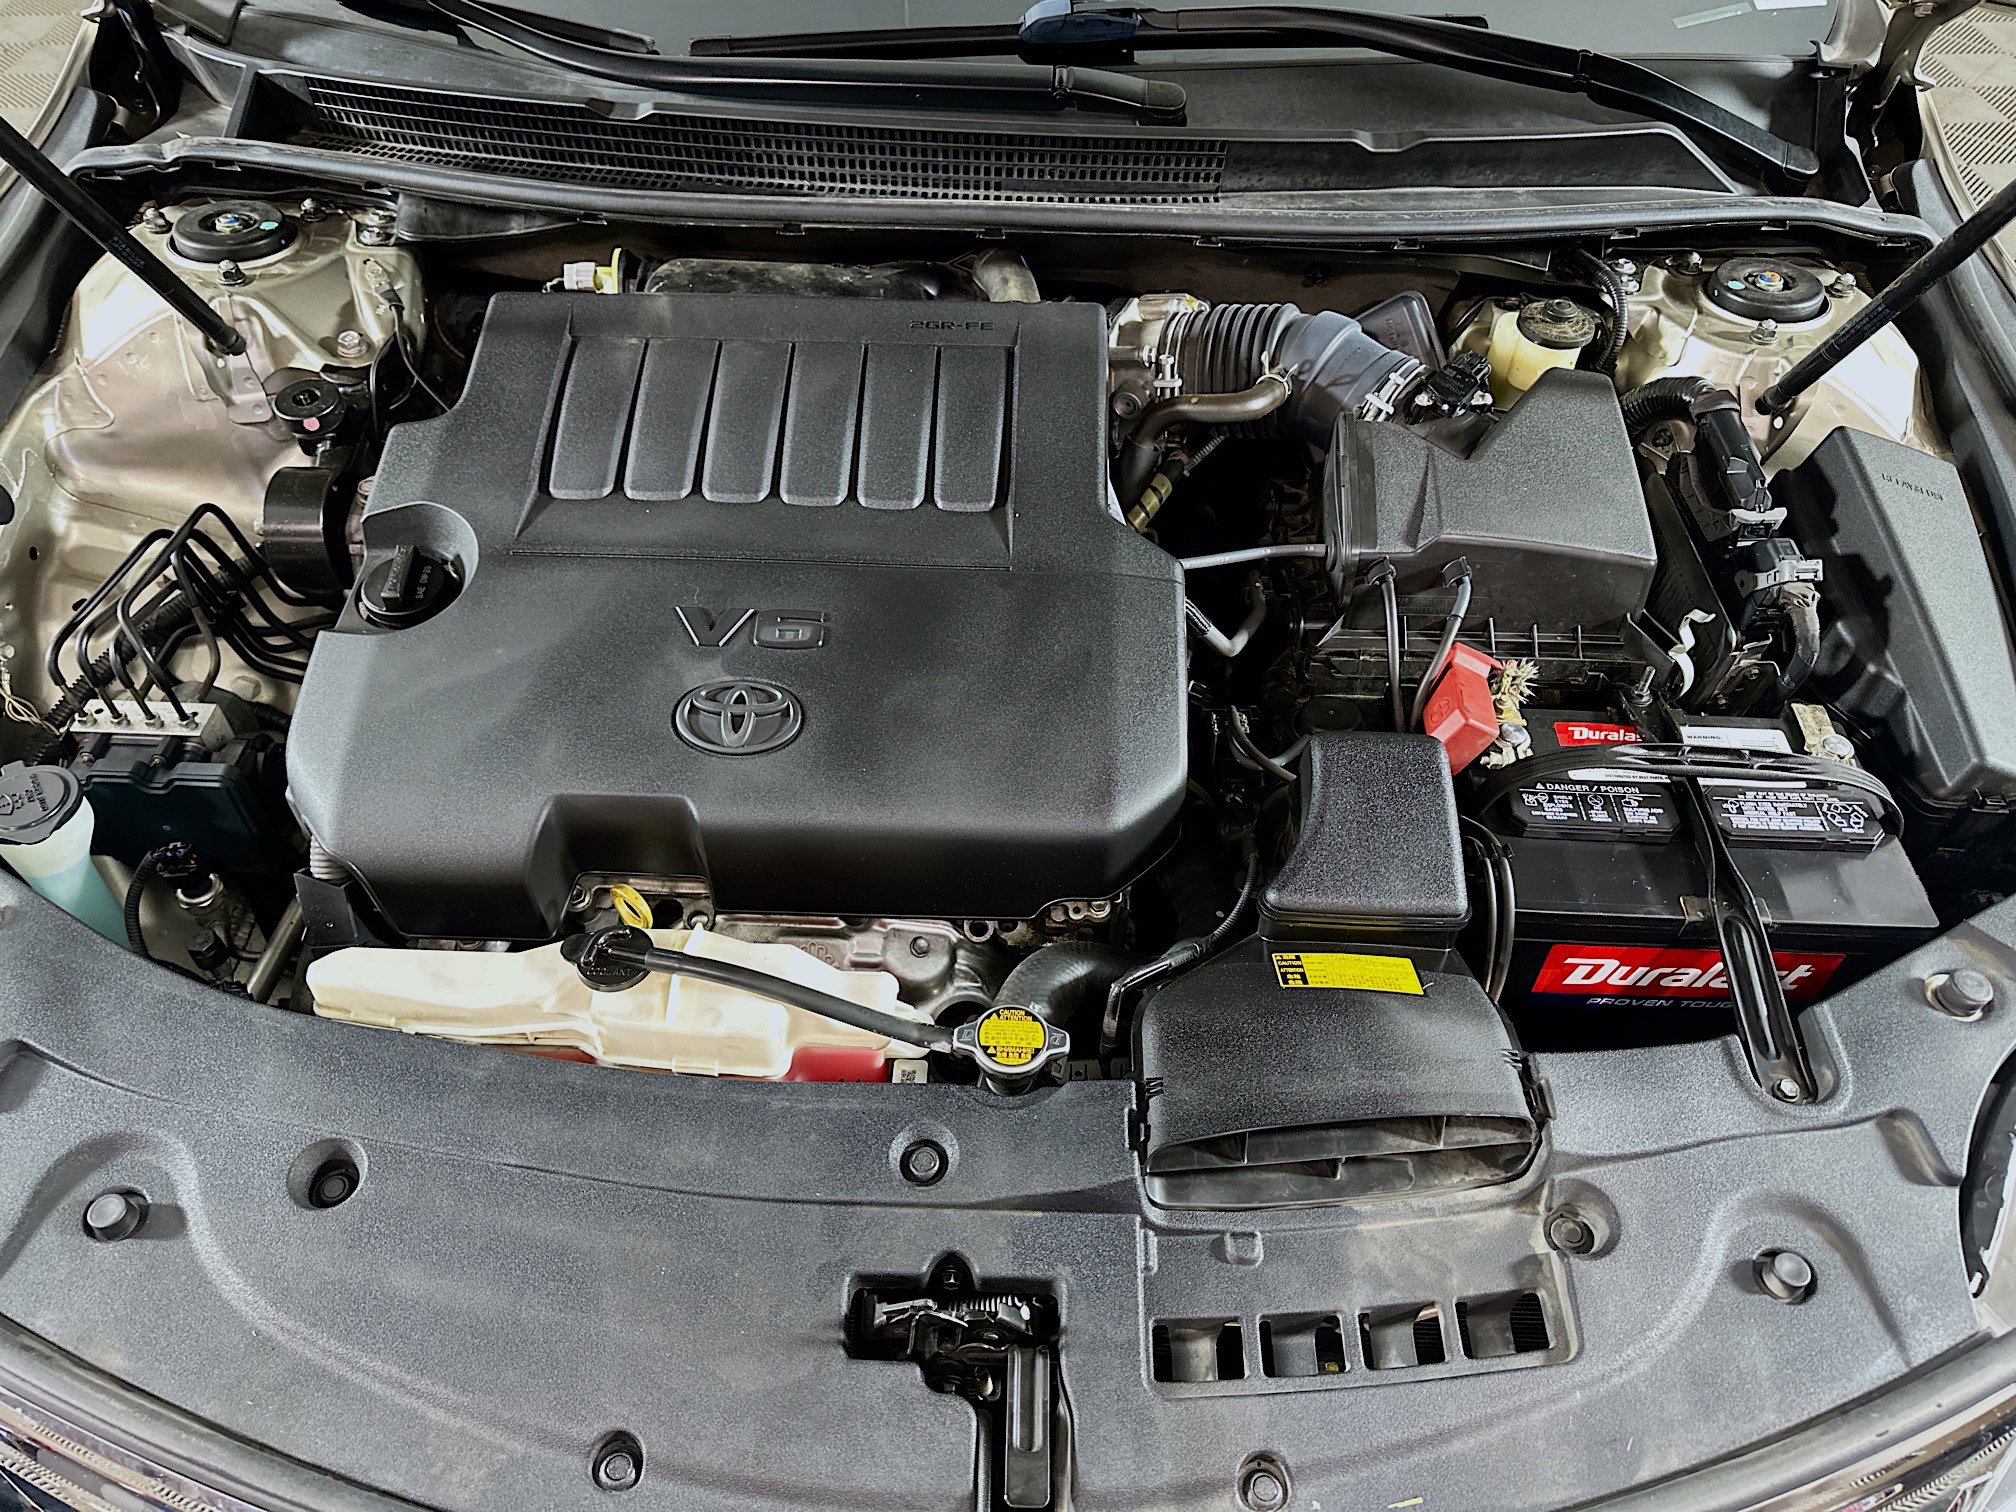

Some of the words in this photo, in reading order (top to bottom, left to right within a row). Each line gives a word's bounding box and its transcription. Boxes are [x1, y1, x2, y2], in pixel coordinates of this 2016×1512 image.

[910, 320, 994, 331] 2GR-FE
[415, 586, 427, 600] SAE
[674, 606, 826, 651] V6
[1568, 727, 1643, 742] Durala
[1546, 783, 1591, 792] DANGER
[1600, 785, 1640, 794] POISON
[586, 967, 631, 977] COOLANT
[1562, 958, 1812, 990] Duralt
[1586, 997, 1674, 1007] PROVEN
[1680, 1000, 1733, 1009] TOUG
[999, 1009, 1026, 1017] CAUTION
